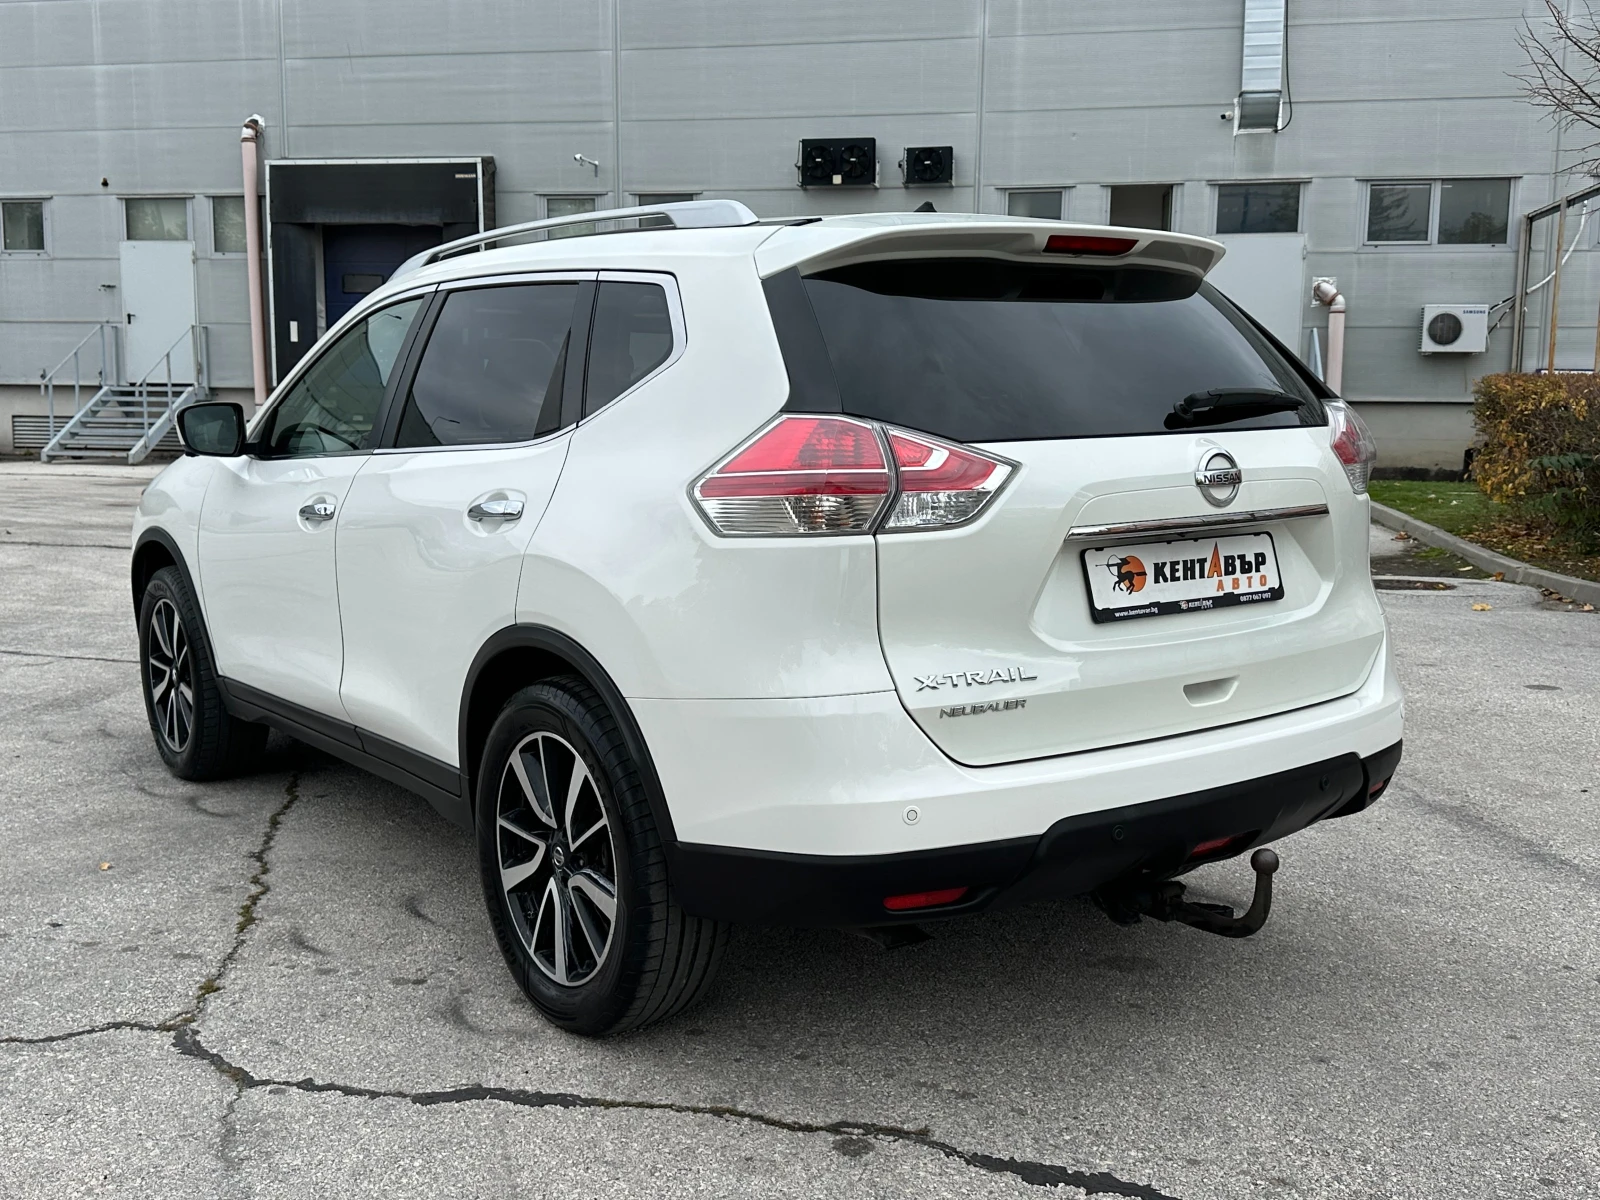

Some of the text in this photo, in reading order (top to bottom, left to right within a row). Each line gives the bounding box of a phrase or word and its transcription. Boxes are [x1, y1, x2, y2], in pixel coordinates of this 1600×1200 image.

[1203, 472, 1240, 484] NISSAN
[1153, 541, 1267, 585] КЕНТАВЪР
[1216, 574, 1268, 592] АВТО
[1239, 594, 1252, 602] 0877
[914, 666, 1038, 692] X-TRAIL
[939, 698, 1027, 719] NEUBAUER
